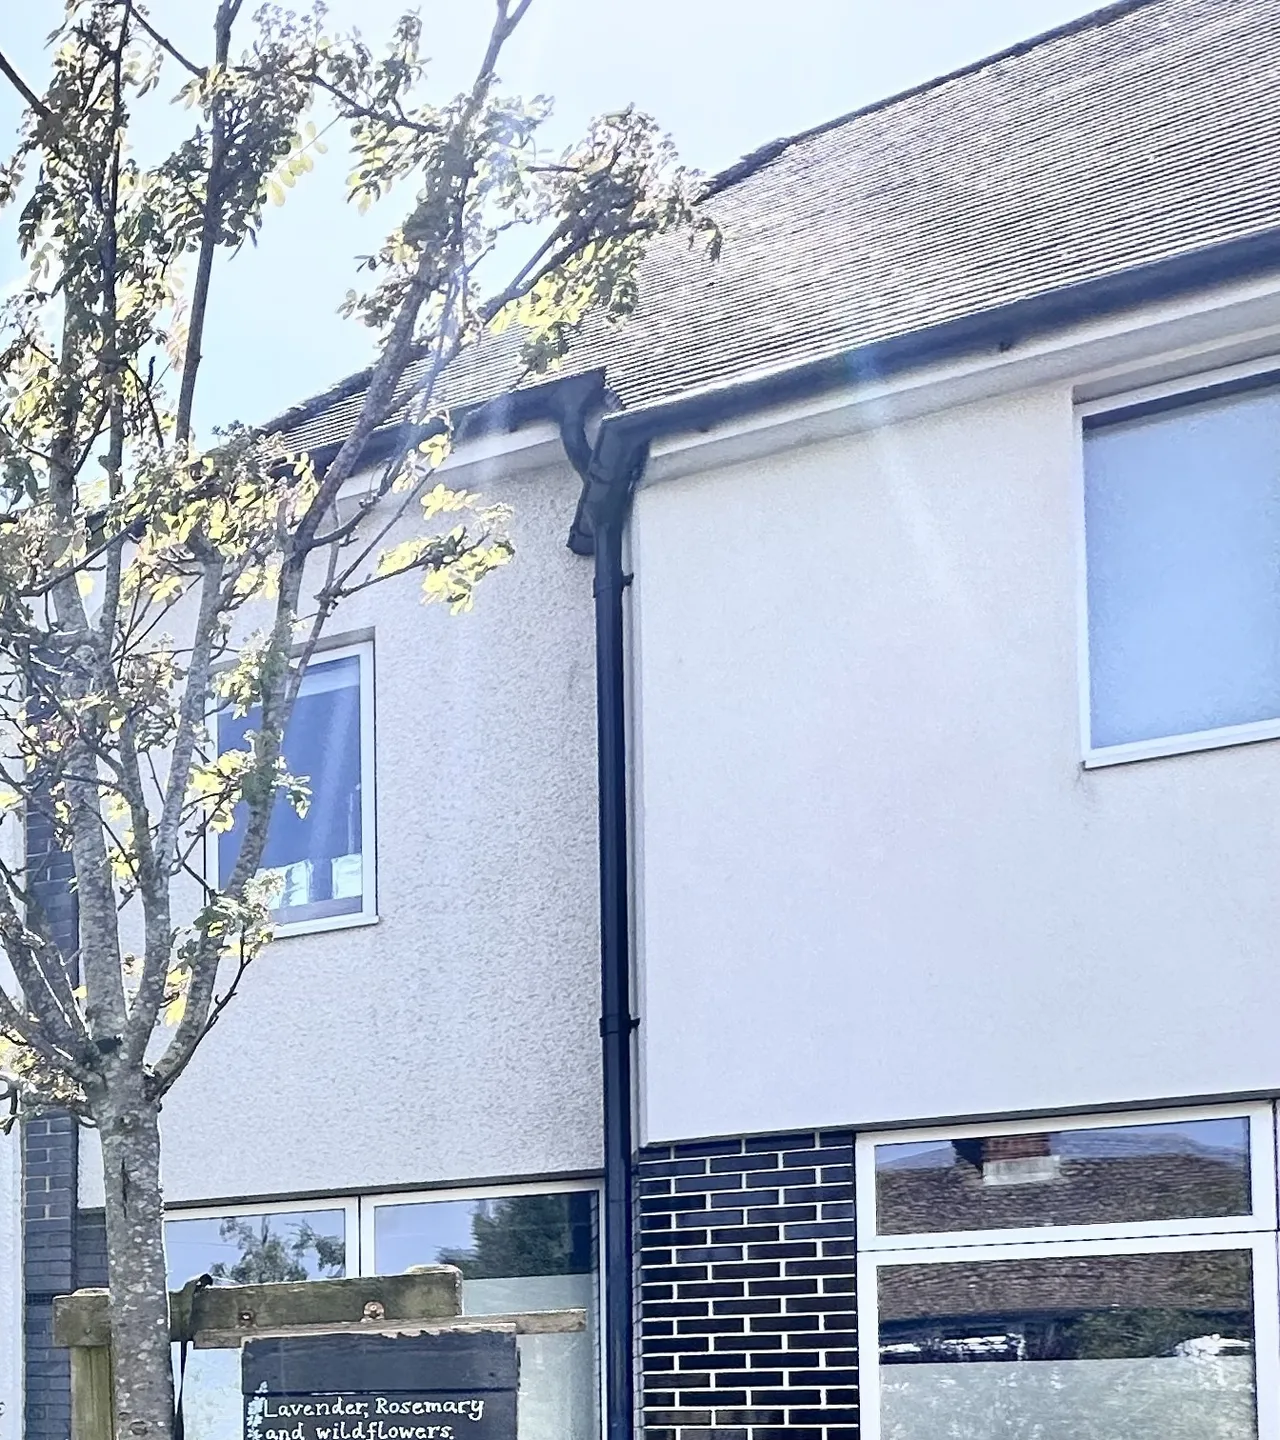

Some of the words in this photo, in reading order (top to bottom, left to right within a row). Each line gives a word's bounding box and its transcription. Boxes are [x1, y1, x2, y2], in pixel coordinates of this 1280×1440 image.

[264, 1396, 369, 1419] Lavender,
[375, 1397, 485, 1421] Rosemary
[265, 1421, 305, 1440] and
